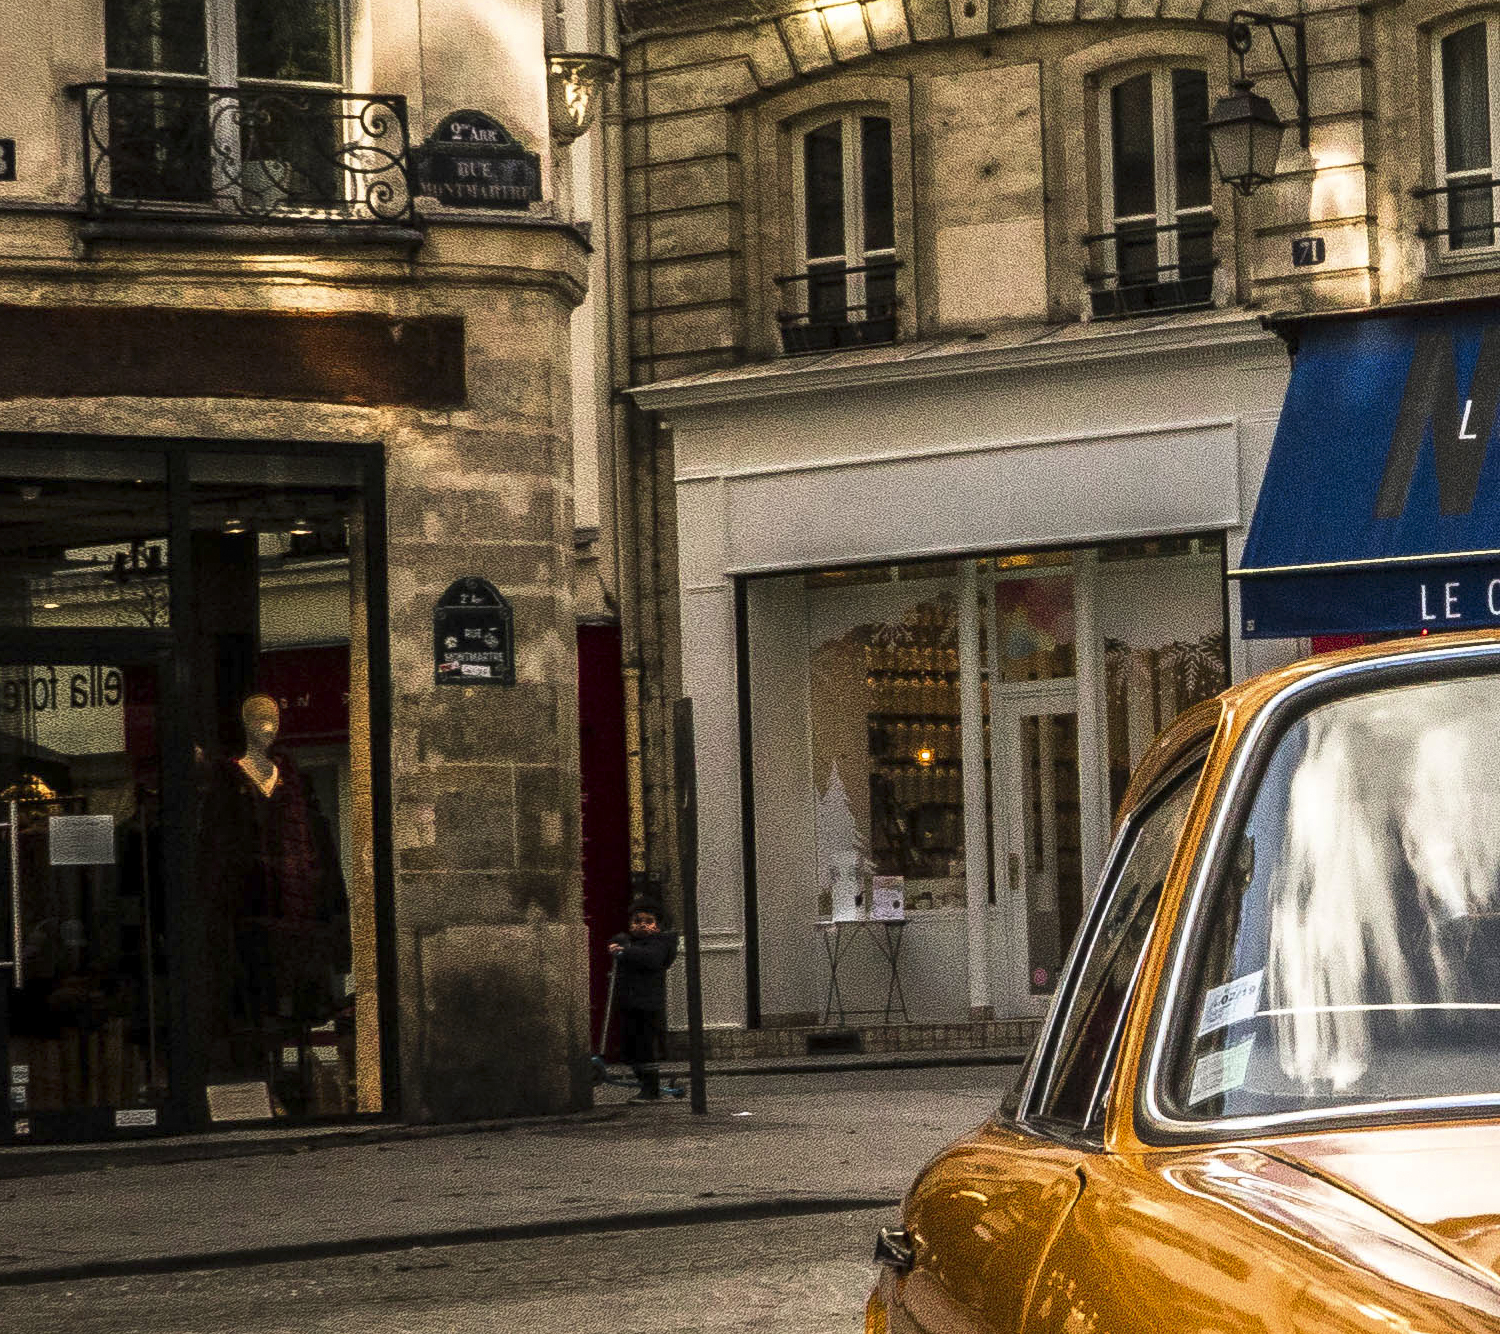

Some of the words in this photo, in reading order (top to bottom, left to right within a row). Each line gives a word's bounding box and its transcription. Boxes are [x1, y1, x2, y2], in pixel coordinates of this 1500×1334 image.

[456, 160, 493, 177] RUE
[1299, 239, 1319, 264] 71
[1419, 583, 1462, 622] LE
